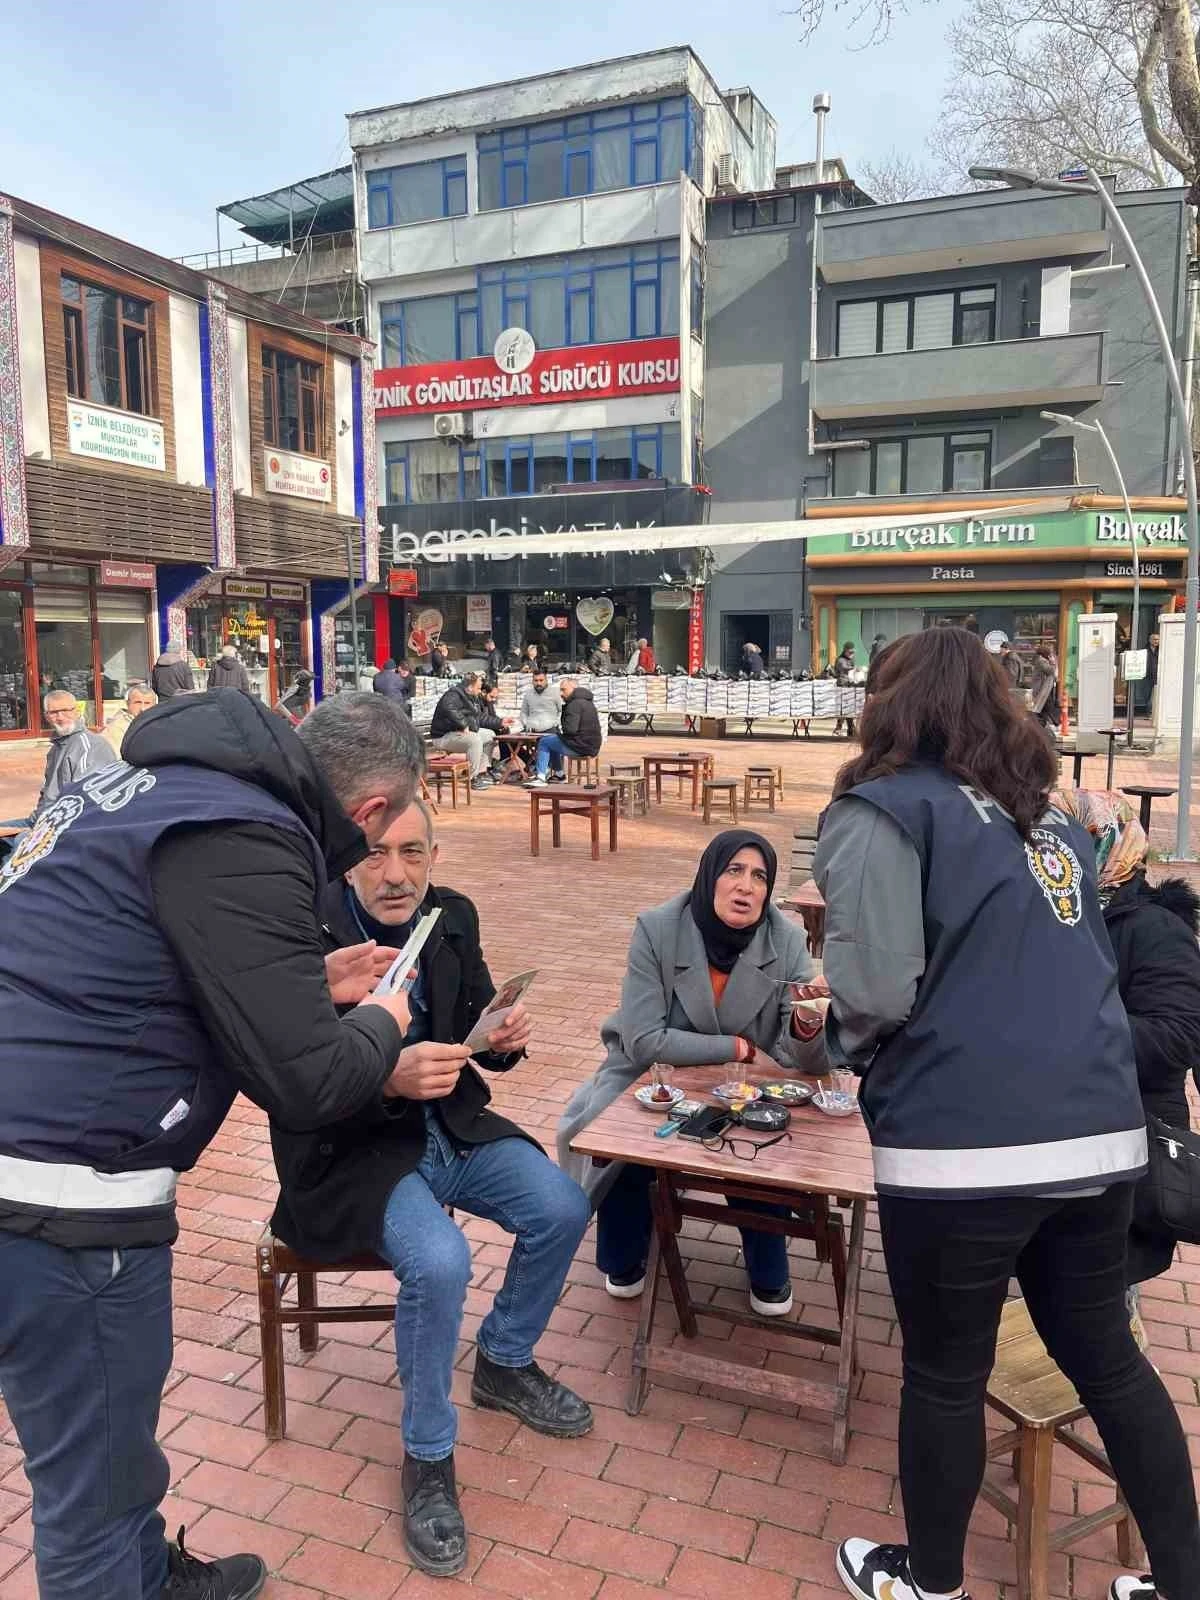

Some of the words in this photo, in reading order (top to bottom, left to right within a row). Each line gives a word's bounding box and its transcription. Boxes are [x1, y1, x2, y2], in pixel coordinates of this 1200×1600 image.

[374, 381, 412, 408] ZNİK
[415, 373, 532, 405] GÖNÜLTAŞLAR
[540, 360, 611, 394] SÜRÜCÜ
[618, 358, 680, 387] KURSU
[392, 516, 528, 564] bambi
[851, 523, 956, 551] Burçak
[1097, 515, 1189, 547] Burçak
[931, 566, 975, 580] Pasta
[1140, 563, 1163, 576] 1981
